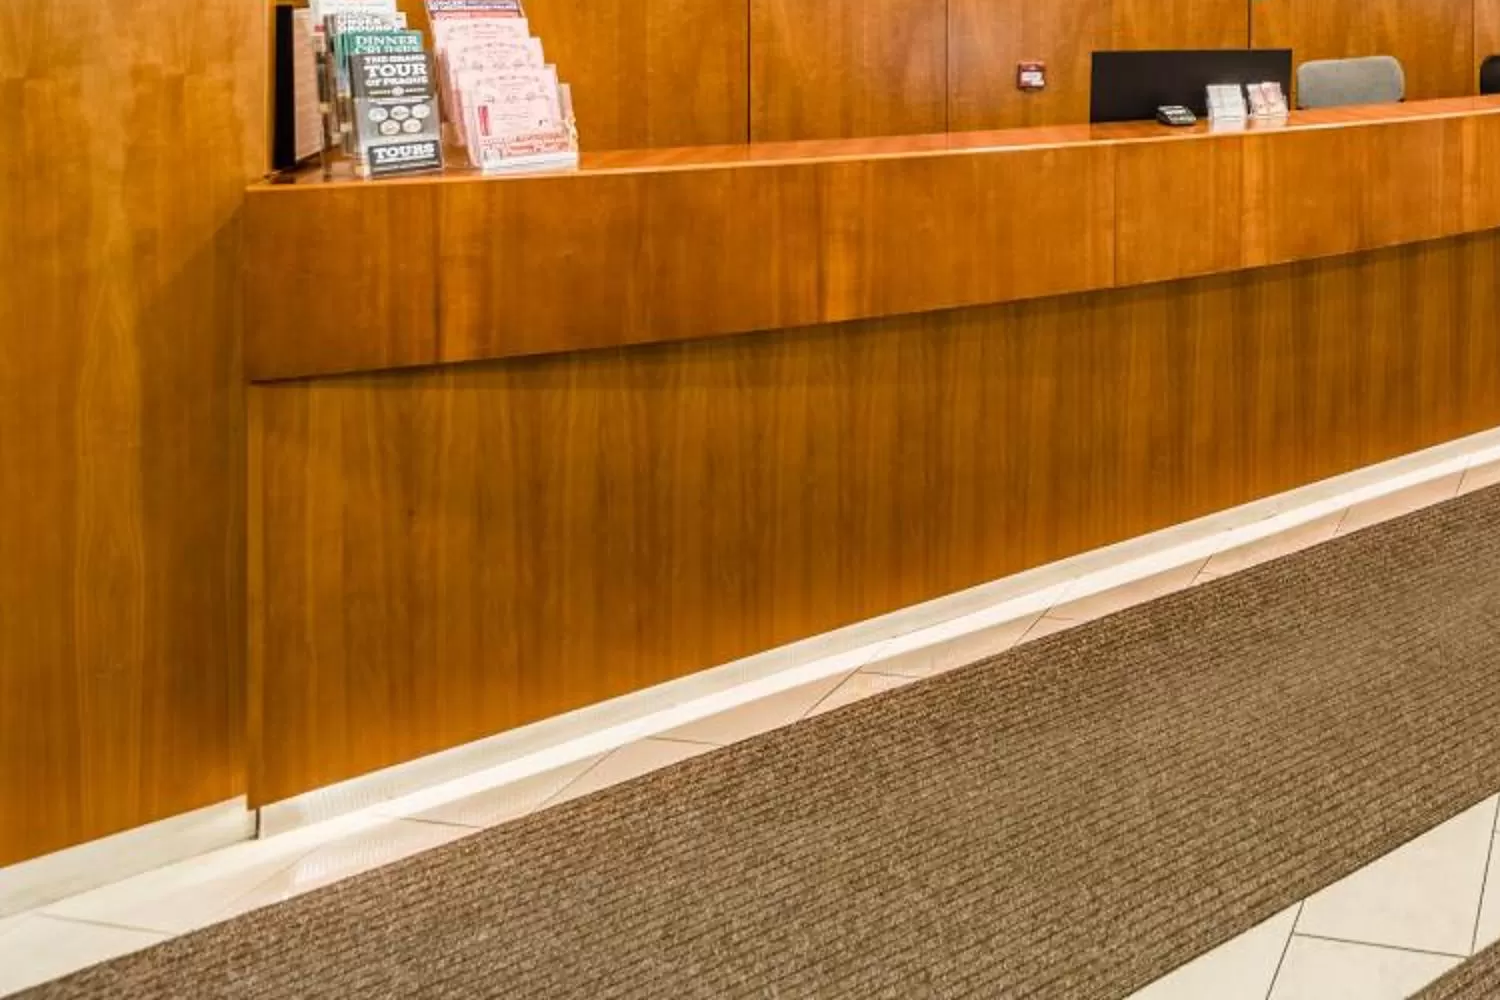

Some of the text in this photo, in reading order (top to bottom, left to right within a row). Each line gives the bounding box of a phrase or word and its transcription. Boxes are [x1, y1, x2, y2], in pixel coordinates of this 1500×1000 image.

[356, 35, 418, 46] DINNER
[364, 64, 428, 77] TOUR
[372, 143, 435, 159] TOURS
